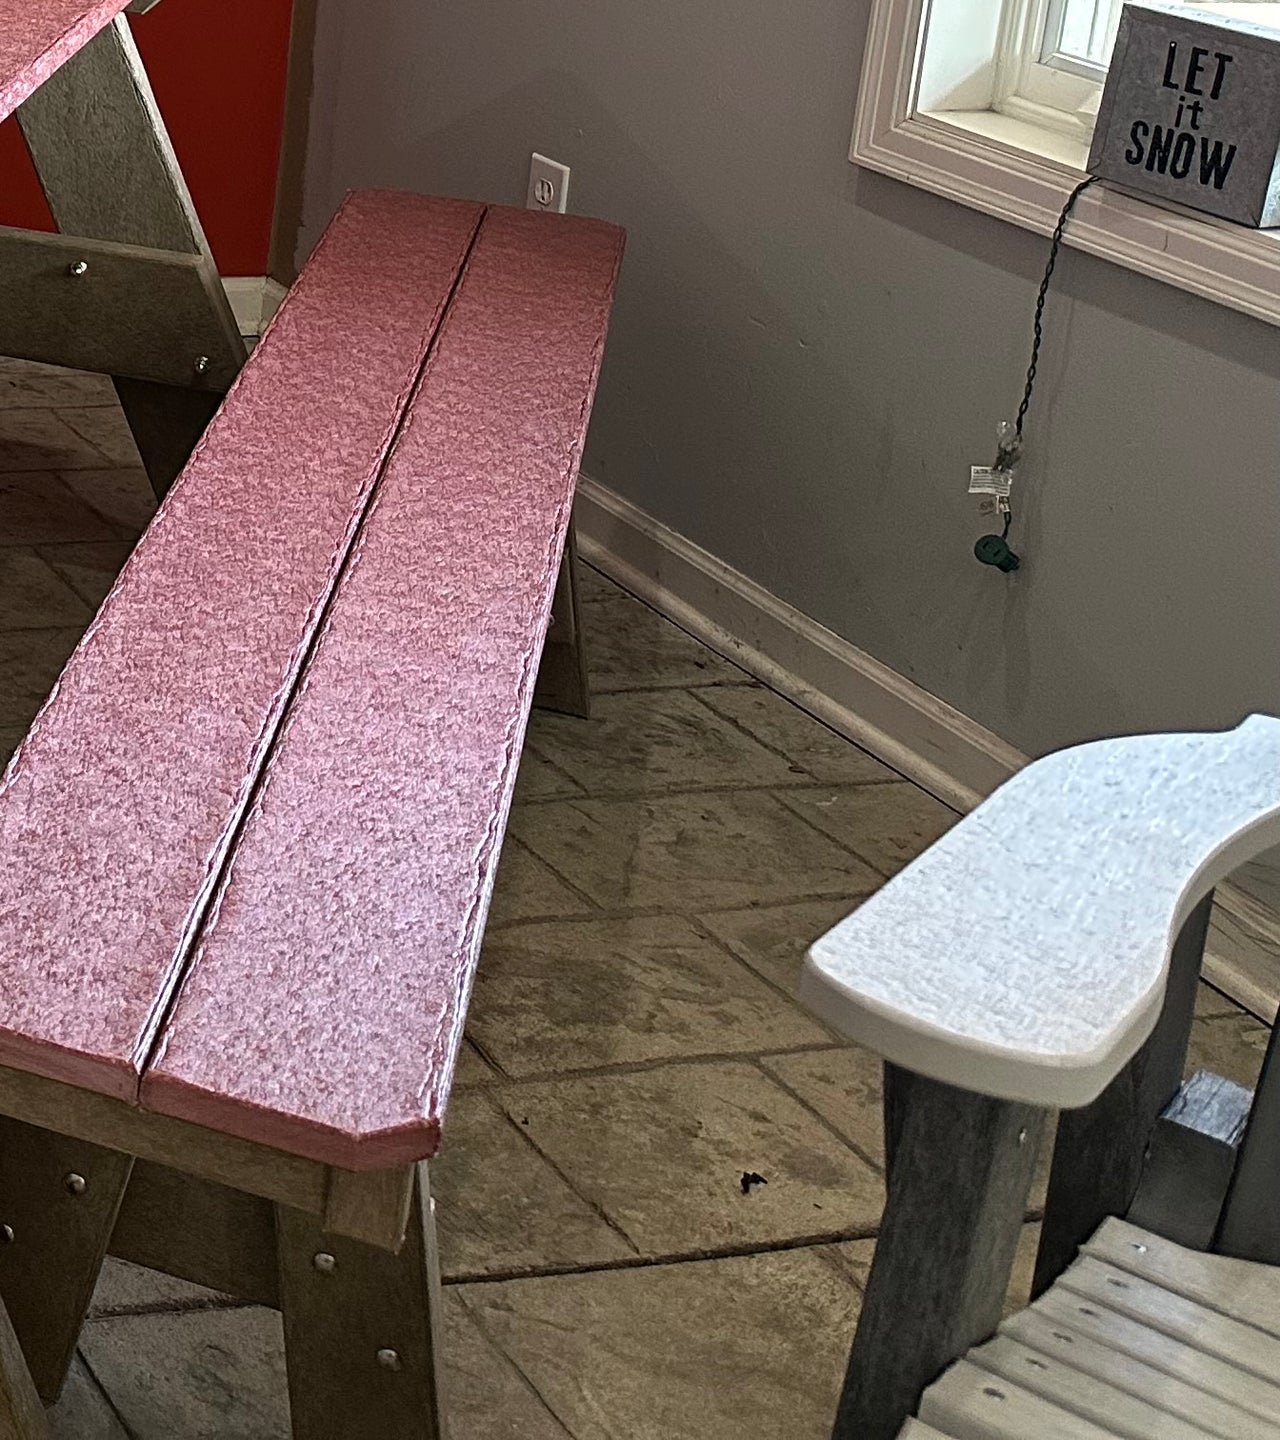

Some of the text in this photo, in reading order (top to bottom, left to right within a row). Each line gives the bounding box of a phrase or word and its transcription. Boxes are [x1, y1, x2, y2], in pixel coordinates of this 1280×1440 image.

[1163, 41, 1234, 100] LET
[1175, 96, 1204, 131] it
[1125, 120, 1237, 190] SNOW
